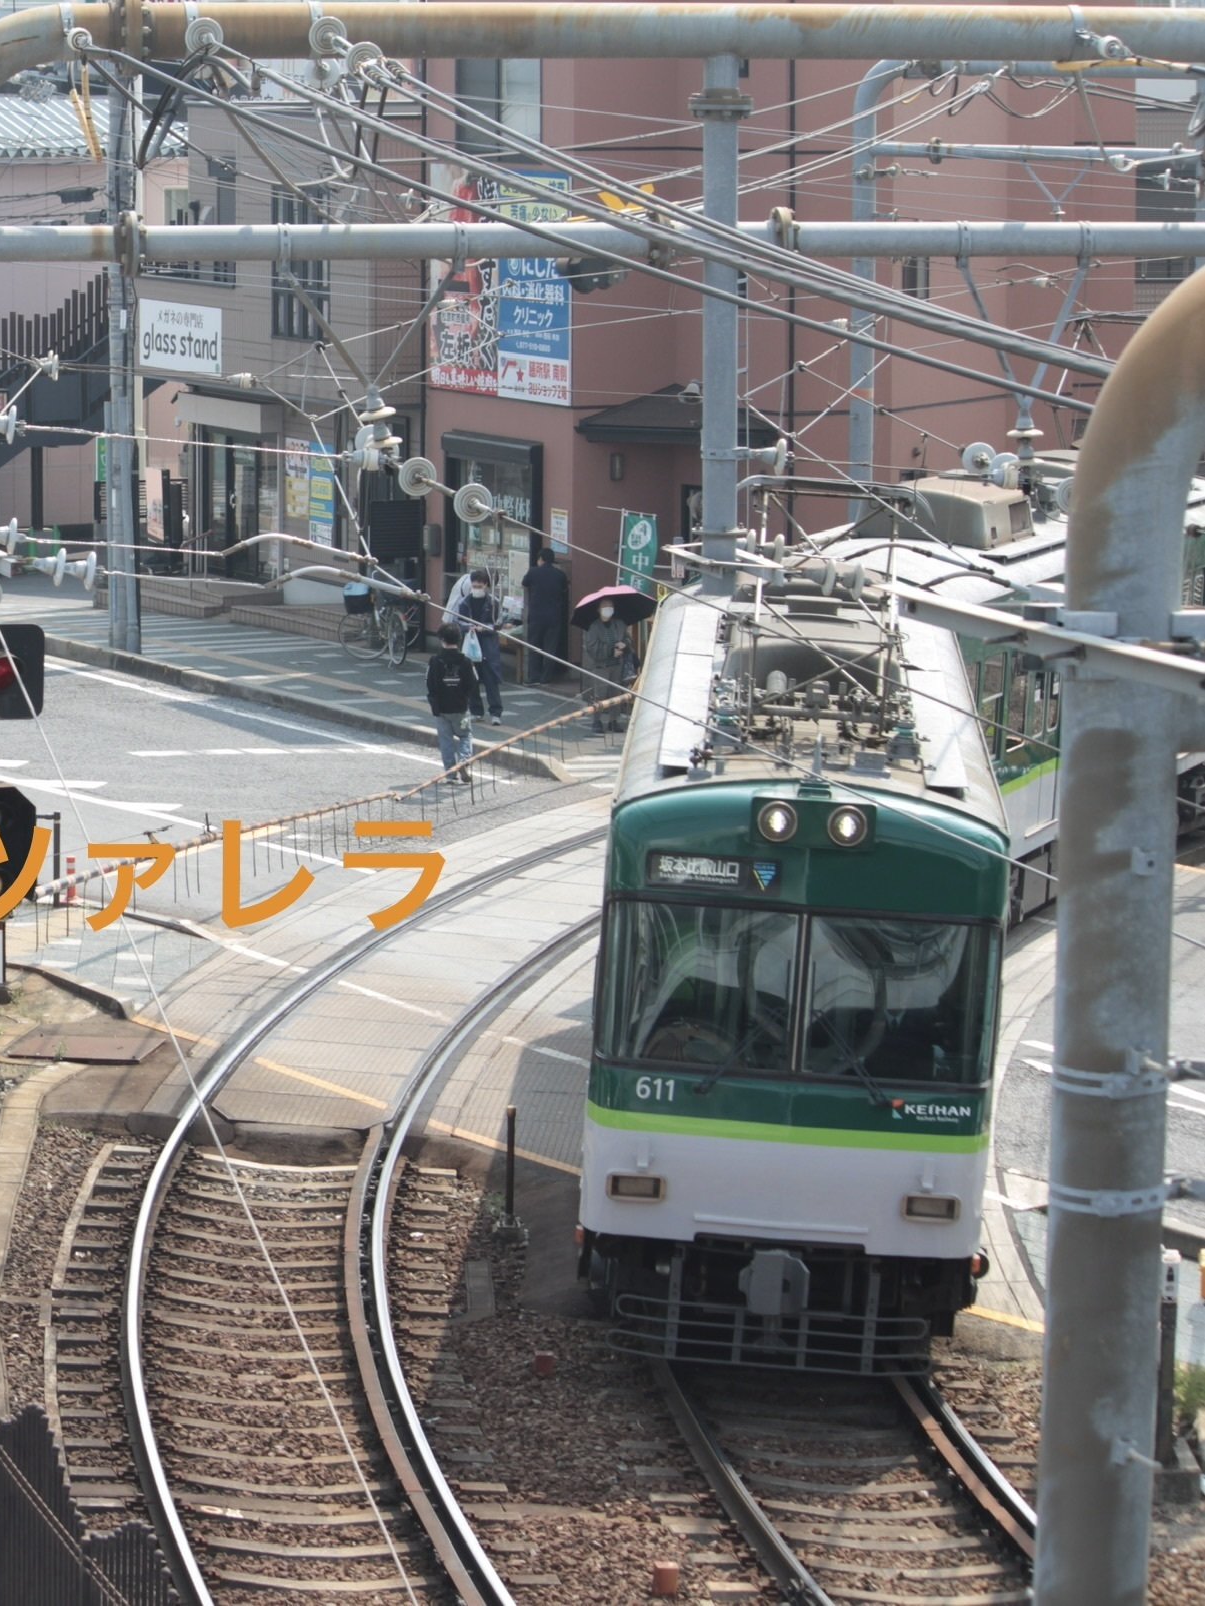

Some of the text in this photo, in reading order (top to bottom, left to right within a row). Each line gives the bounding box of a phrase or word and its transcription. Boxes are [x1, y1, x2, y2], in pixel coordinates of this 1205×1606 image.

[157, 308, 205, 329] メガネの専門店
[513, 304, 554, 328] クリニック
[143, 322, 218, 361] glass stand
[636, 1076, 676, 1102] 611
[904, 1104, 971, 1117] KEIHAN
